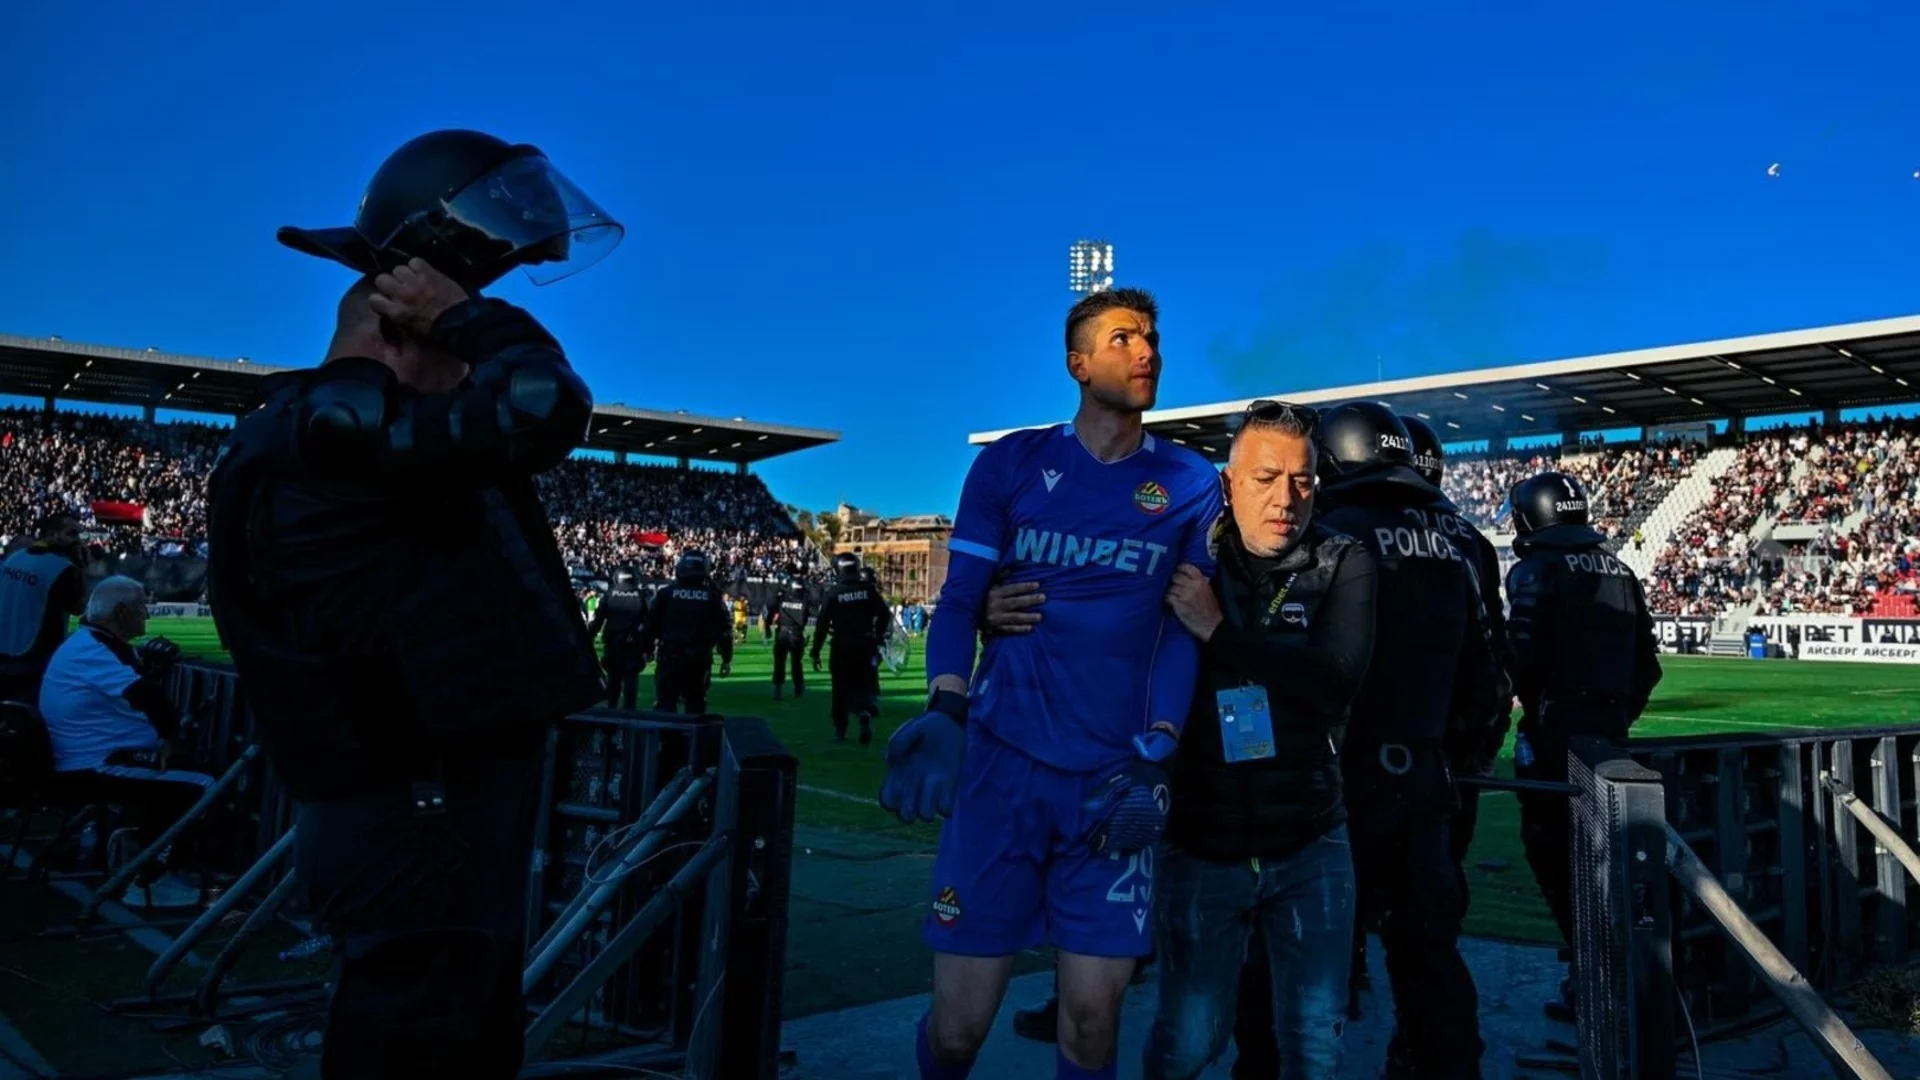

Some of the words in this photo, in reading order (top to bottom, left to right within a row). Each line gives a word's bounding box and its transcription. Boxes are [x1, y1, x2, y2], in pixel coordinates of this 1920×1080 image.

[1015, 527, 1168, 576] WINBET
[1375, 527, 1462, 561] POLICE
[1564, 553, 1631, 577] POLICE
[672, 588, 709, 600] POLICE
[838, 590, 869, 604] POLICE
